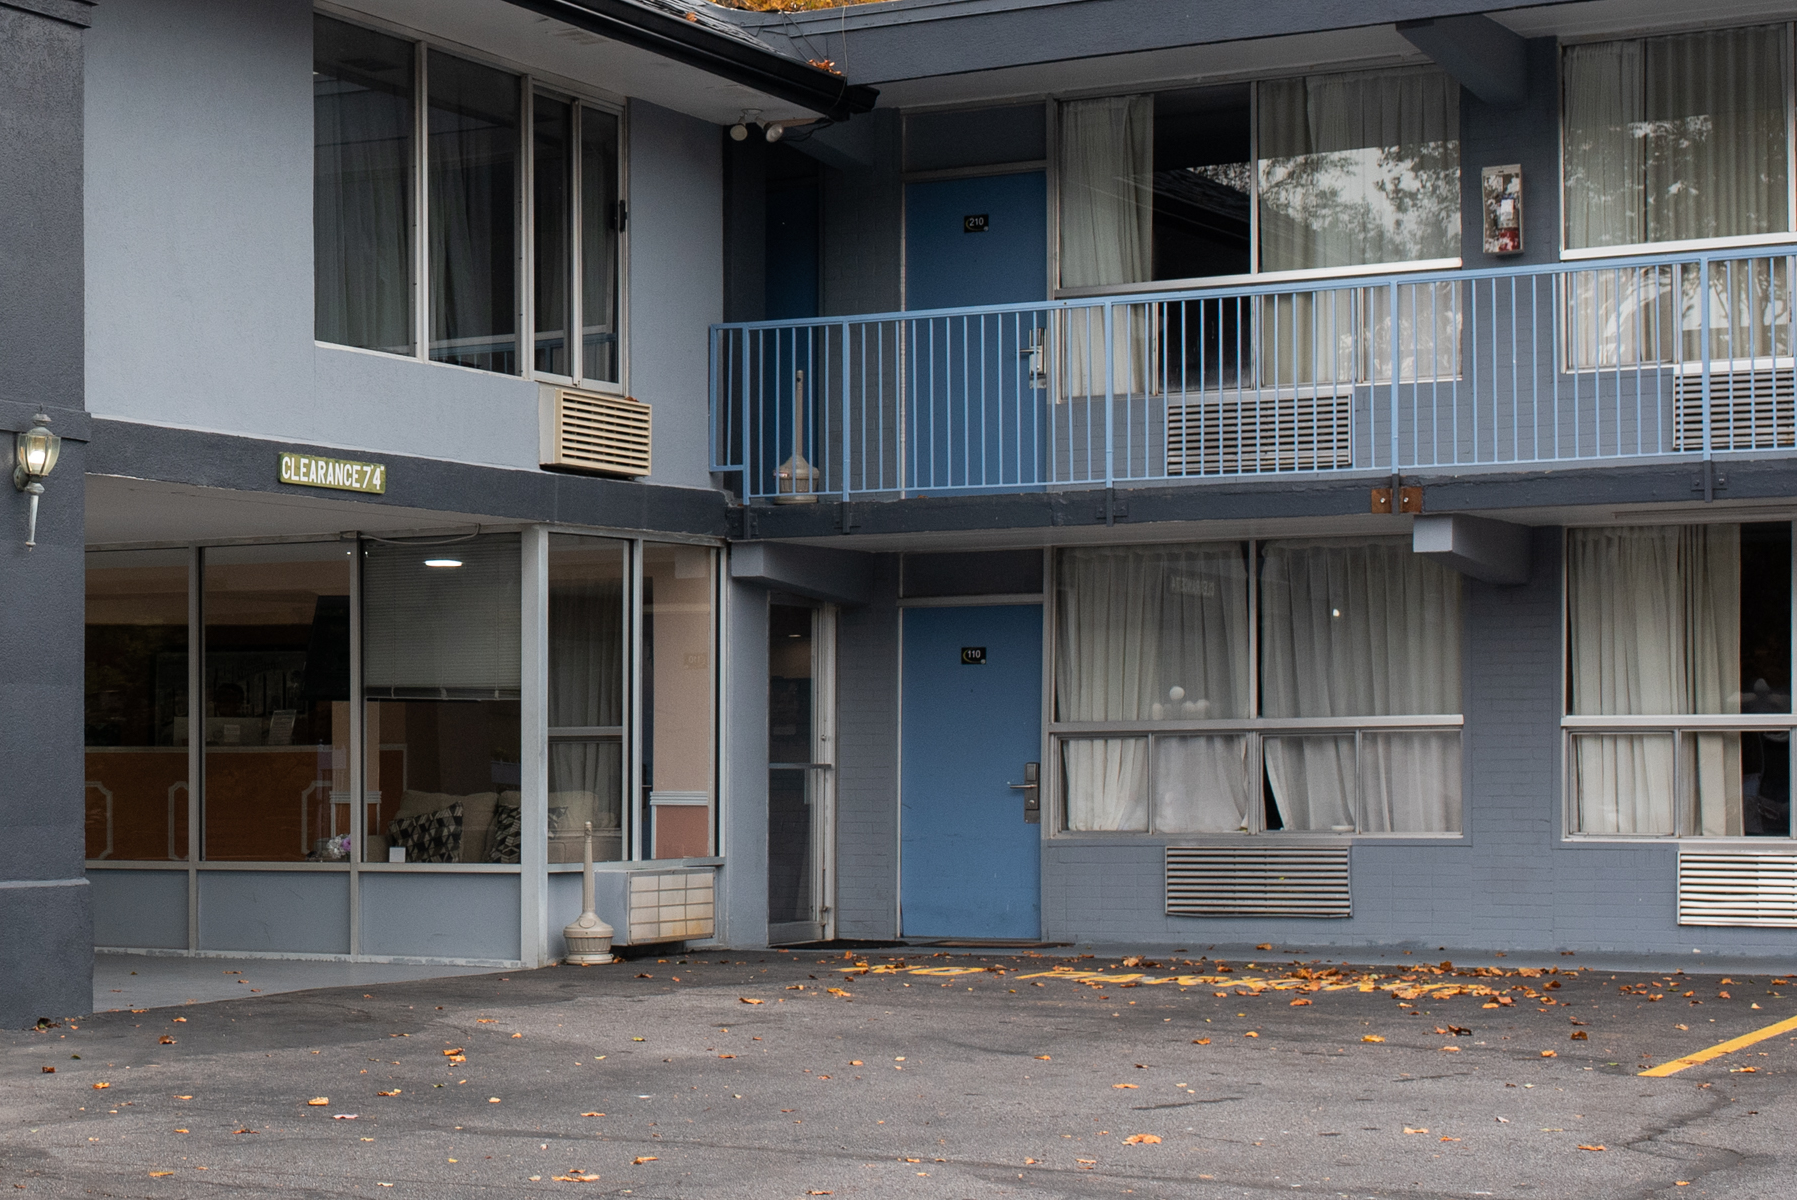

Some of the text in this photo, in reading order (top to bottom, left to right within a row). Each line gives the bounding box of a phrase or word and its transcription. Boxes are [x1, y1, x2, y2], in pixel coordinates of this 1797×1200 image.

[969, 217, 984, 227] 210
[282, 456, 361, 488] CLEARANCE
[967, 649, 981, 659] 110
